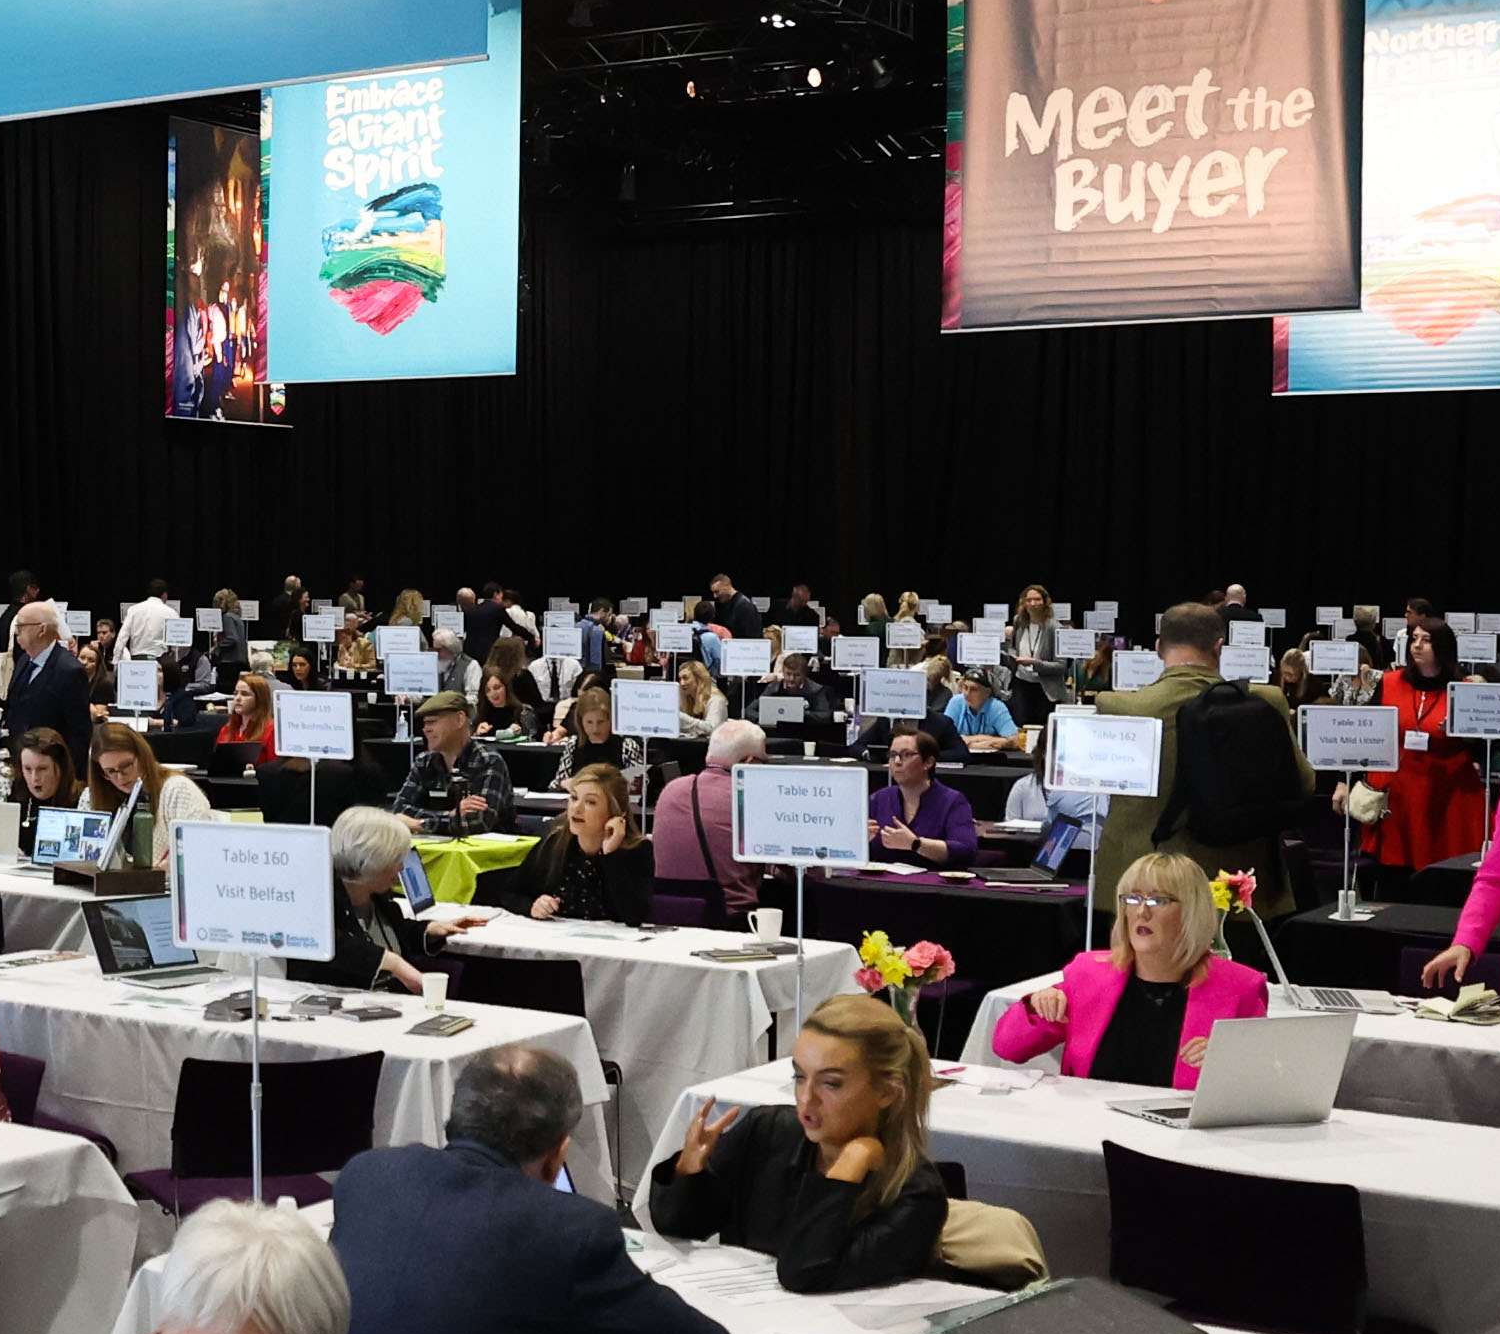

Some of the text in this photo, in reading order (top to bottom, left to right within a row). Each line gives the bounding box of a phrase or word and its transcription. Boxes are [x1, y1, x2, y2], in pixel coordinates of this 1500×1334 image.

[325, 78, 443, 120] Embrace
[1004, 68, 1315, 160] Meet the
[323, 136, 445, 198] Spirit
[1053, 145, 1288, 234] Buyer
[777, 784, 833, 797] Table 161
[775, 811, 834, 826] Visit Derry
[223, 849, 289, 865] Table 160
[216, 884, 295, 903] Visit Belfast
